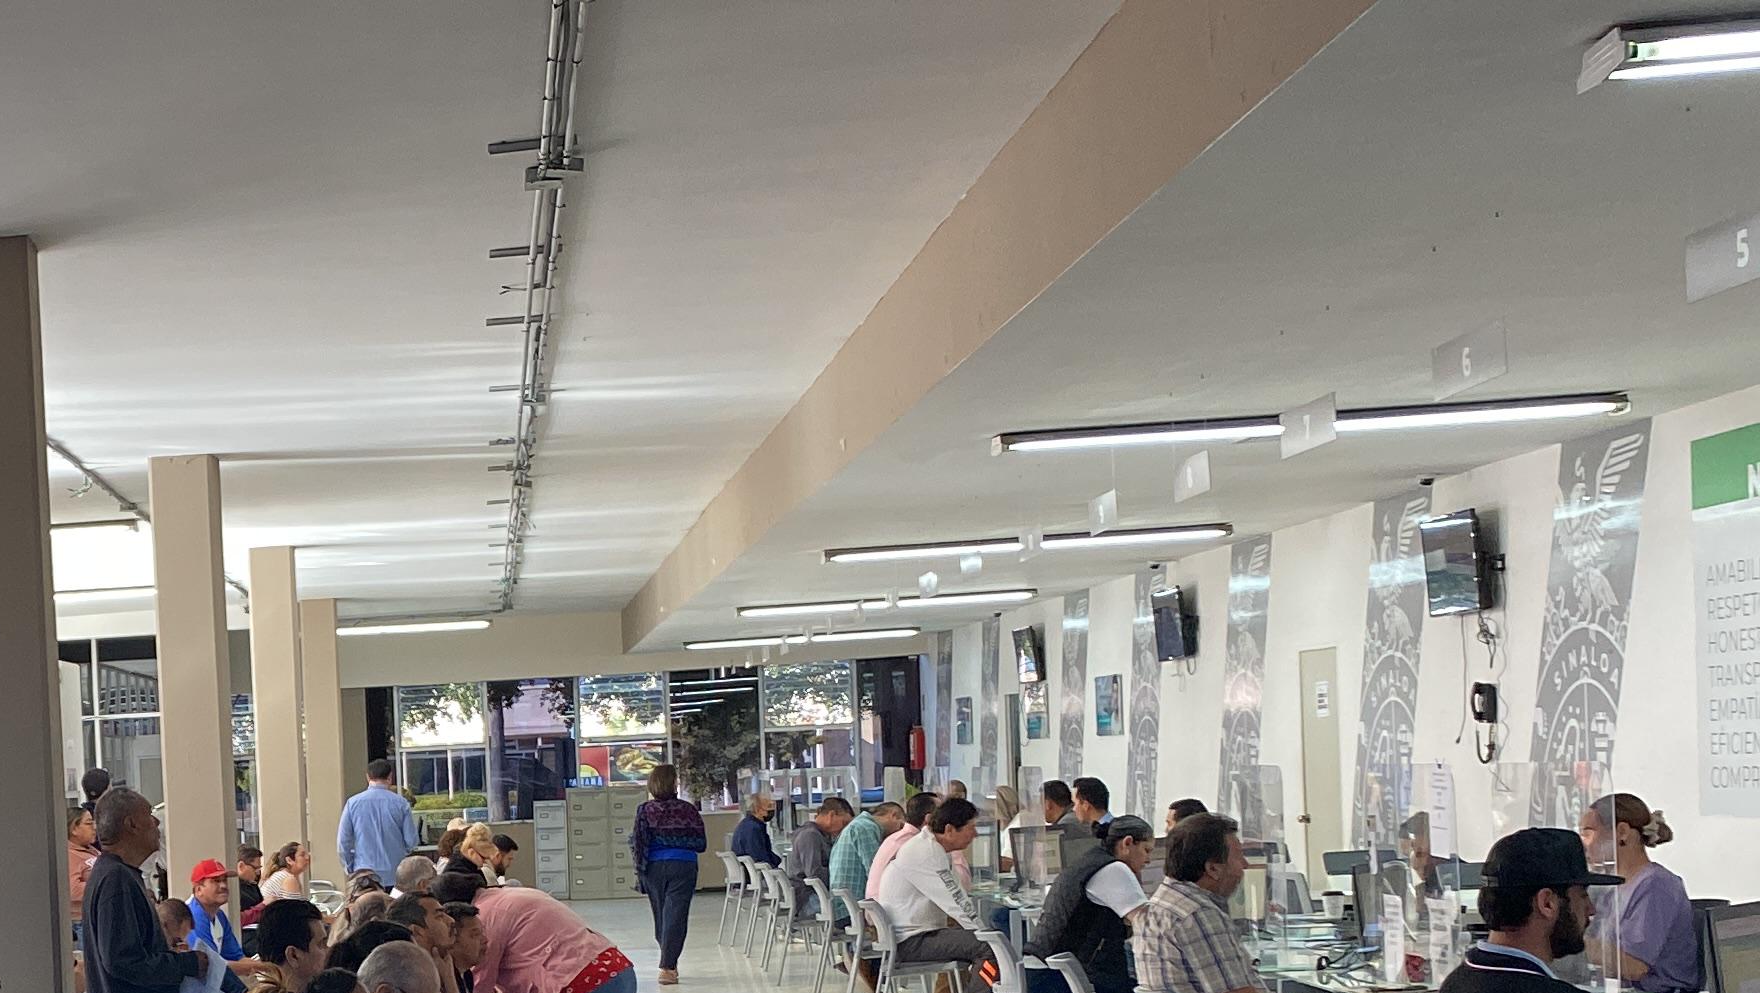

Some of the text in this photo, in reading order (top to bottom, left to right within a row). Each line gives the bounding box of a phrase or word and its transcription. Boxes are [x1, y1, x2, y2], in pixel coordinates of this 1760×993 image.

[1736, 228, 1749, 268] 5
[1462, 346, 1472, 377] 6
[1553, 644, 1620, 692] SINALOA
